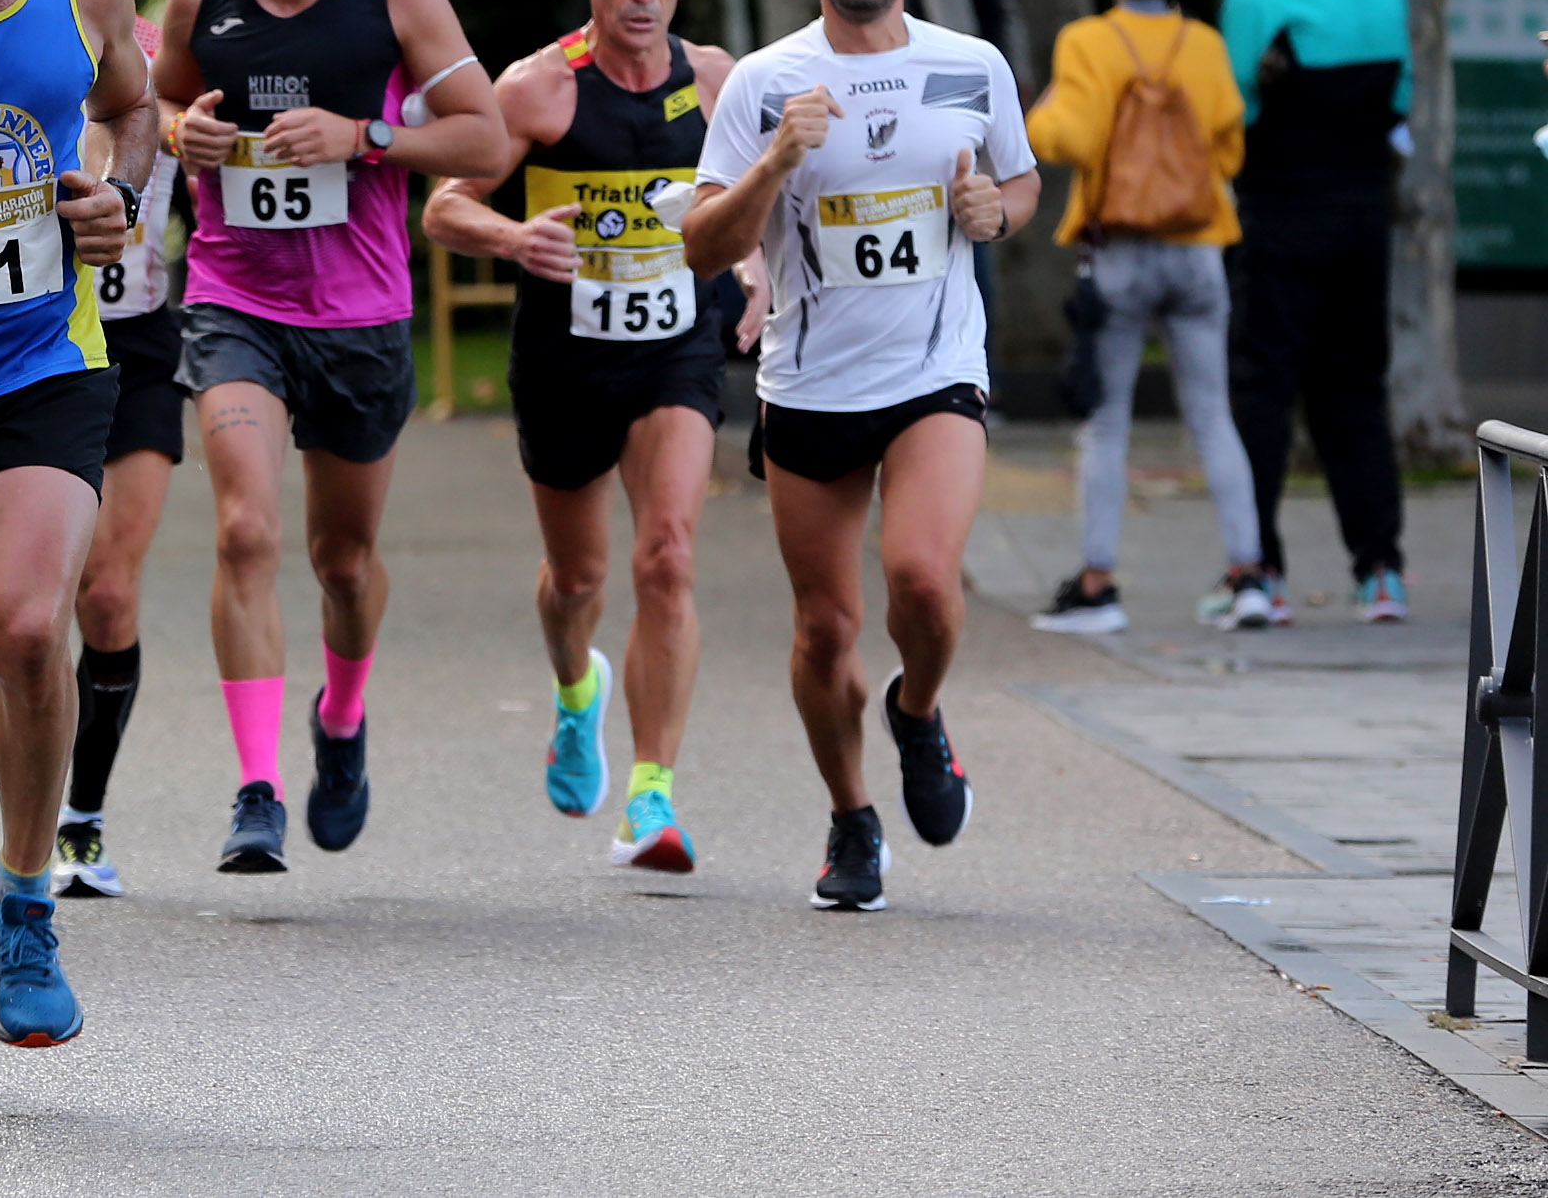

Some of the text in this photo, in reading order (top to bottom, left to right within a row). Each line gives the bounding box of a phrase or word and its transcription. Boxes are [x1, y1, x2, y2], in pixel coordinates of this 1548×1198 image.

[14, 200, 47, 223] 2021
[252, 178, 311, 220] 65
[855, 231, 919, 279] 64
[593, 289, 677, 332] 153
